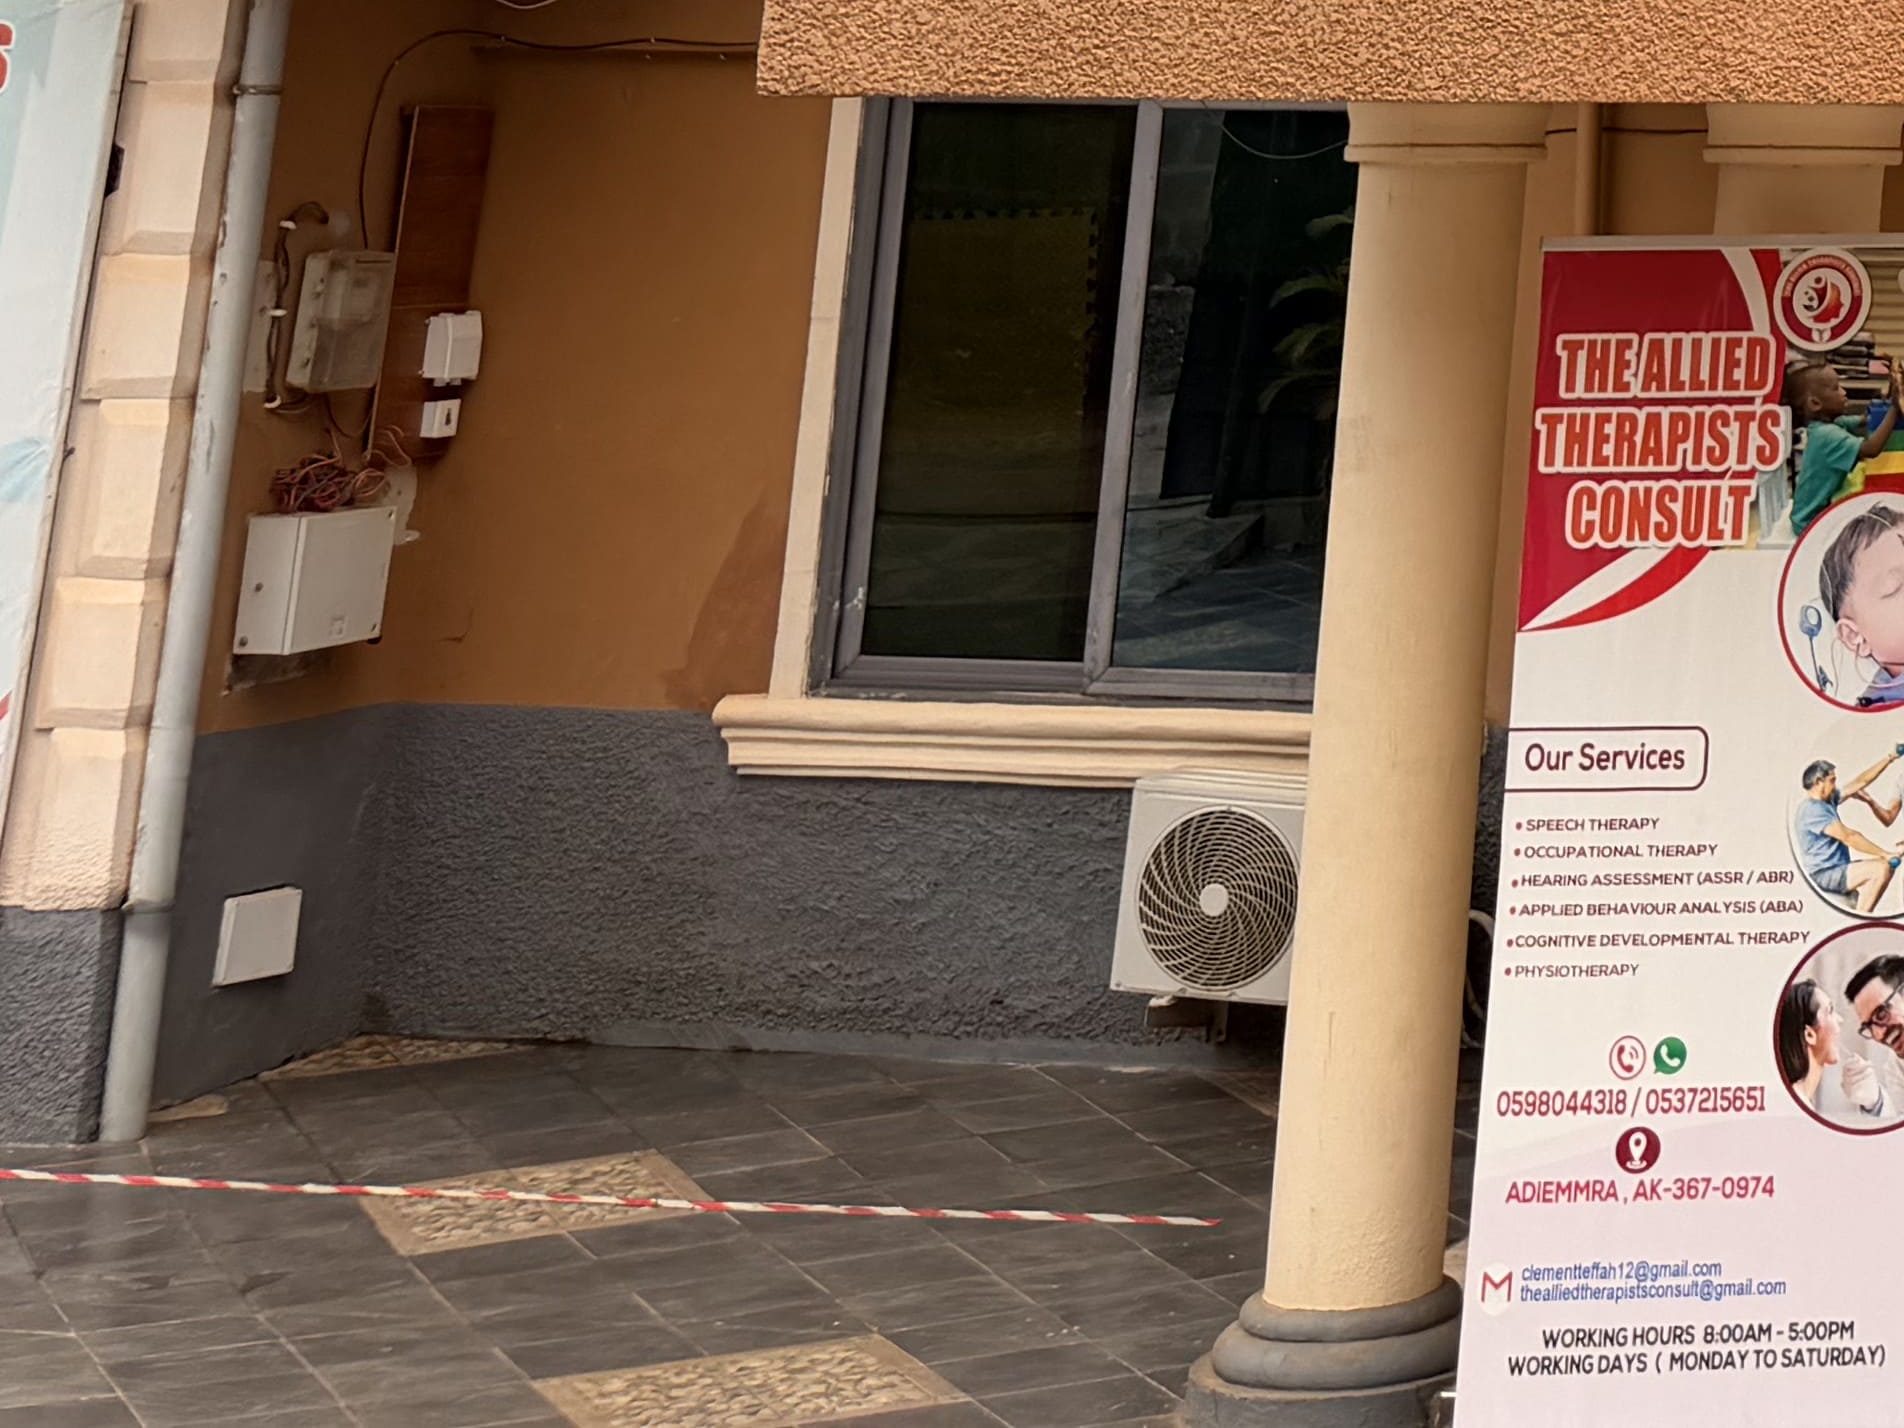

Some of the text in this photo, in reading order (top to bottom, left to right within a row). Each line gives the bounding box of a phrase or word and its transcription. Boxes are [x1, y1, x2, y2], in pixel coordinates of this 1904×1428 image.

[1561, 335, 1772, 394] THE ALLIED
[1540, 409, 1782, 468] THERAPISTS
[1570, 485, 1752, 544] CONSULT
[1525, 742, 1686, 772] Our Services
[1525, 817, 1660, 832] SPEECH THERAPY
[1524, 844, 1719, 859] OCCUPATIONAL THERAPY
[1521, 874, 1588, 887] HEARING
[1590, 872, 1694, 886] ASSESSMENT
[1697, 872, 1744, 885] (ASSR
[1756, 871, 1794, 884] ABR)
[1518, 900, 1804, 917] APPLIED BEHAVIOUR ANALYSIS (ABA)
[1515, 931, 1811, 948] COGNITIVE DEVELOPMENTAL THERAPY
[1514, 964, 1640, 978] PHYSIOTHERAPY
[1496, 1090, 1627, 1117] 0598044318
[1645, 1086, 1766, 1114] 0537215651
[1632, 1175, 1775, 1201] AK-367-0974
[1520, 1278, 1787, 1304] thealliedtherapistsconsult@gmail.com
[1542, 1327, 1629, 1350] WORKING
[1632, 1325, 1697, 1347] HOURS
[1703, 1322, 1773, 1344] 8:00AM
[1787, 1320, 1855, 1342] 5:00PM
[1508, 1353, 1594, 1376] WORKING
[1598, 1351, 1648, 1374] DAYS
[1752, 1347, 1778, 1369] TO
[1780, 1344, 1886, 1368] SATURDAY)
